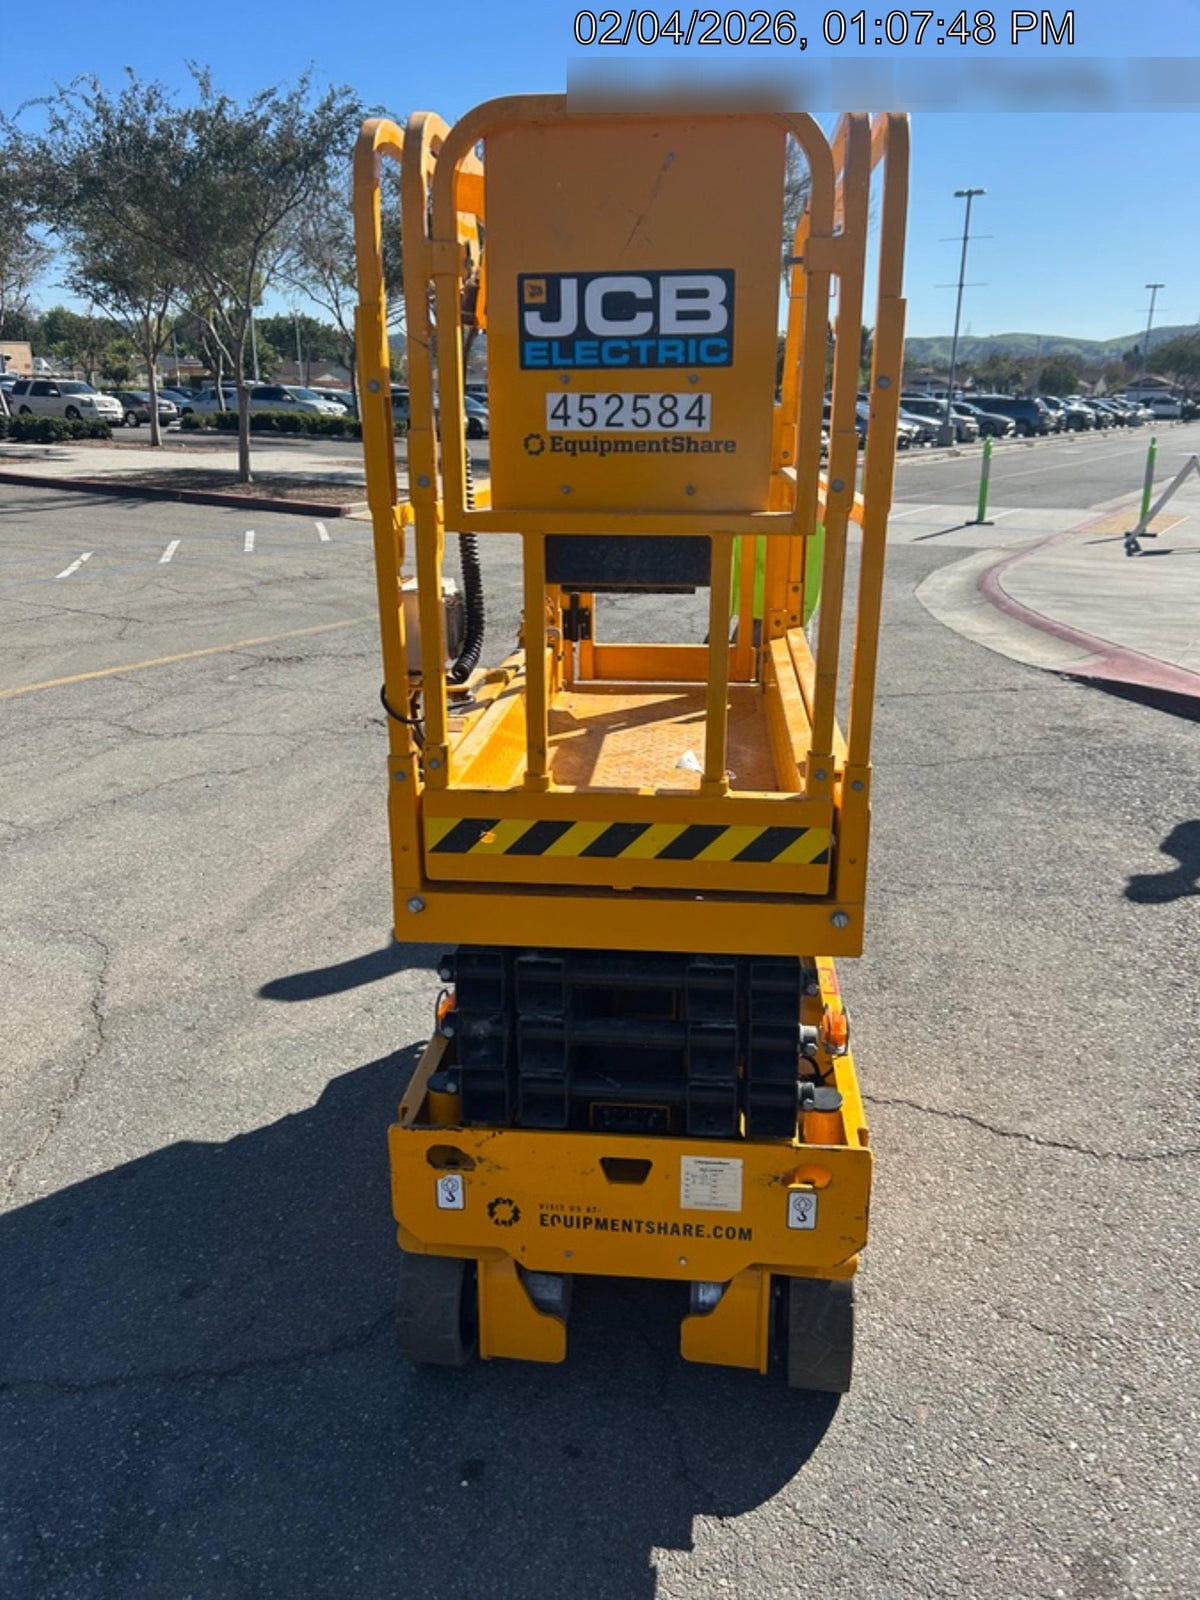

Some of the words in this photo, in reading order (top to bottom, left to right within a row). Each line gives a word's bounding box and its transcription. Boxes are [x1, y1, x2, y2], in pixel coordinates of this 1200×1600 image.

[524, 275, 728, 337] JCB
[524, 338, 728, 366] ELECTRIC
[550, 394, 706, 428] 452584
[550, 436, 737, 456] EquipmentShare
